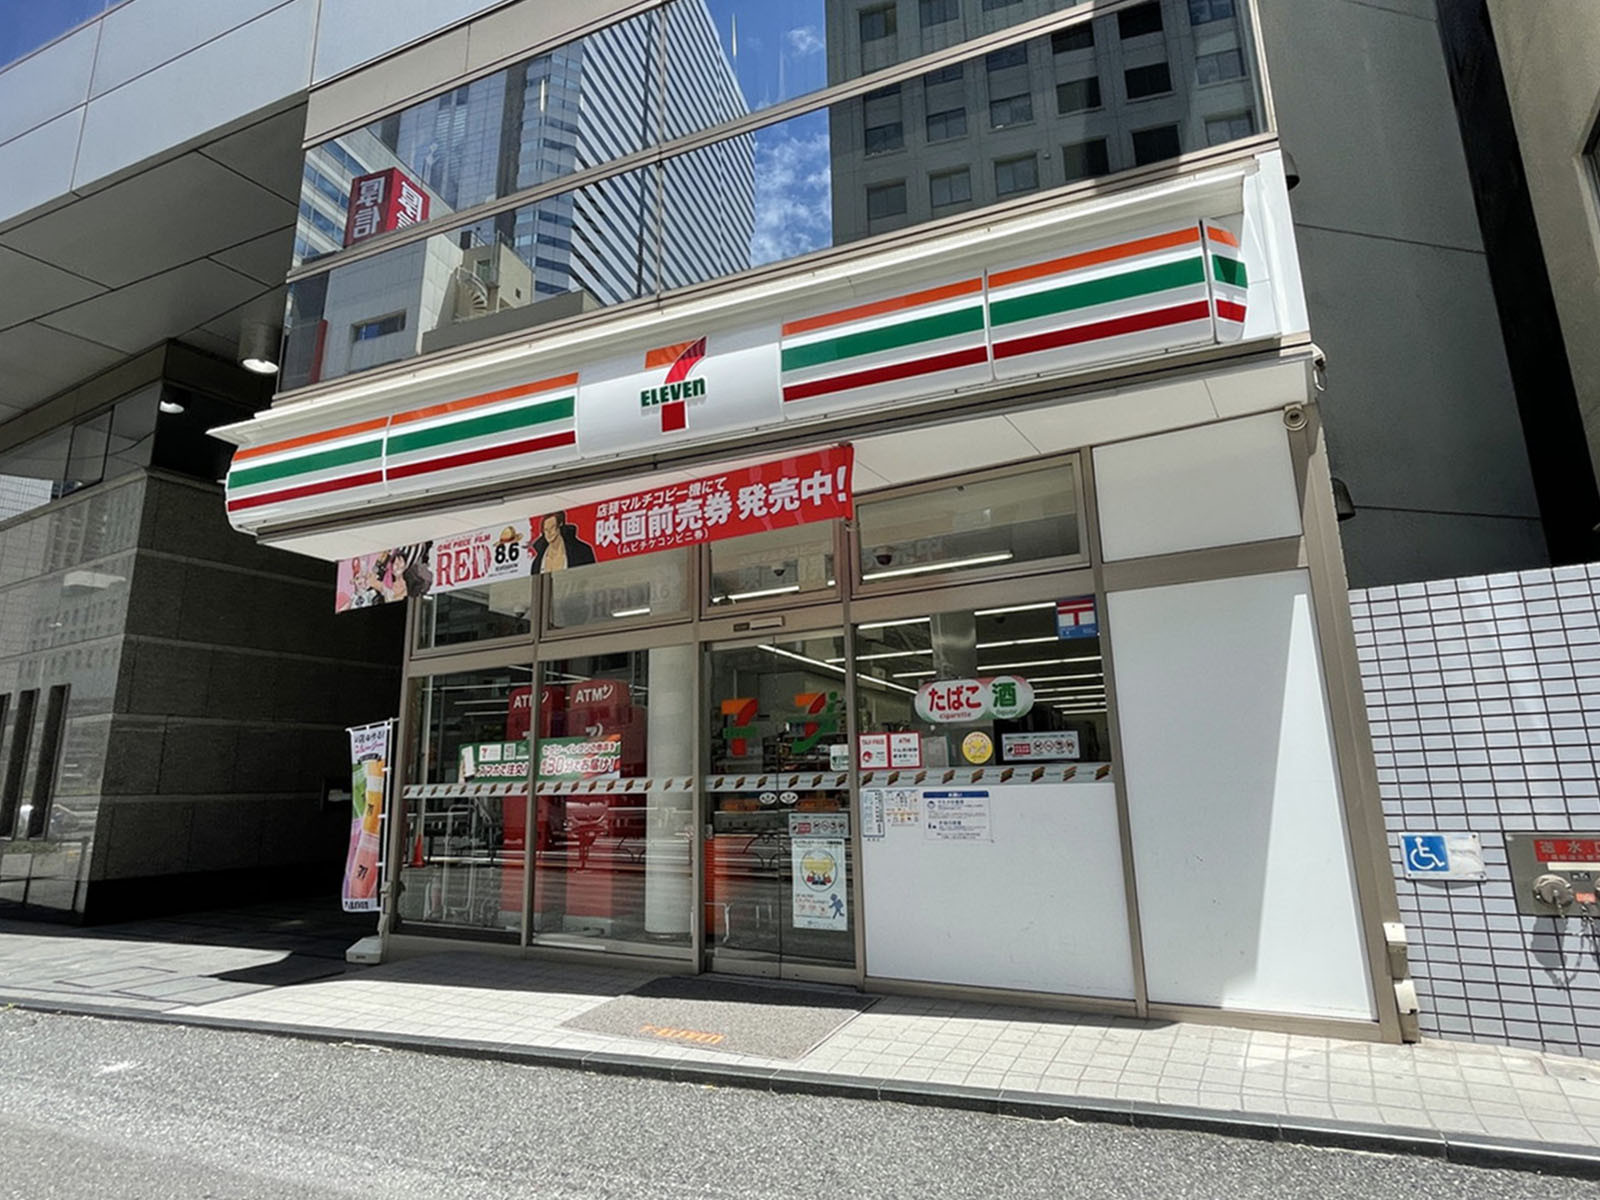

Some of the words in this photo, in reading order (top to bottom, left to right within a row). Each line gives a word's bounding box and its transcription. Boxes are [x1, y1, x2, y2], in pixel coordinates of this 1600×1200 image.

[595, 491, 732, 547] 映画前売券
[737, 465, 847, 520] 発売中!
[436, 544, 492, 587] RED
[494, 541, 520, 564] 8.6
[928, 684, 982, 712] たばこ
[992, 682, 1017, 708] 酒
